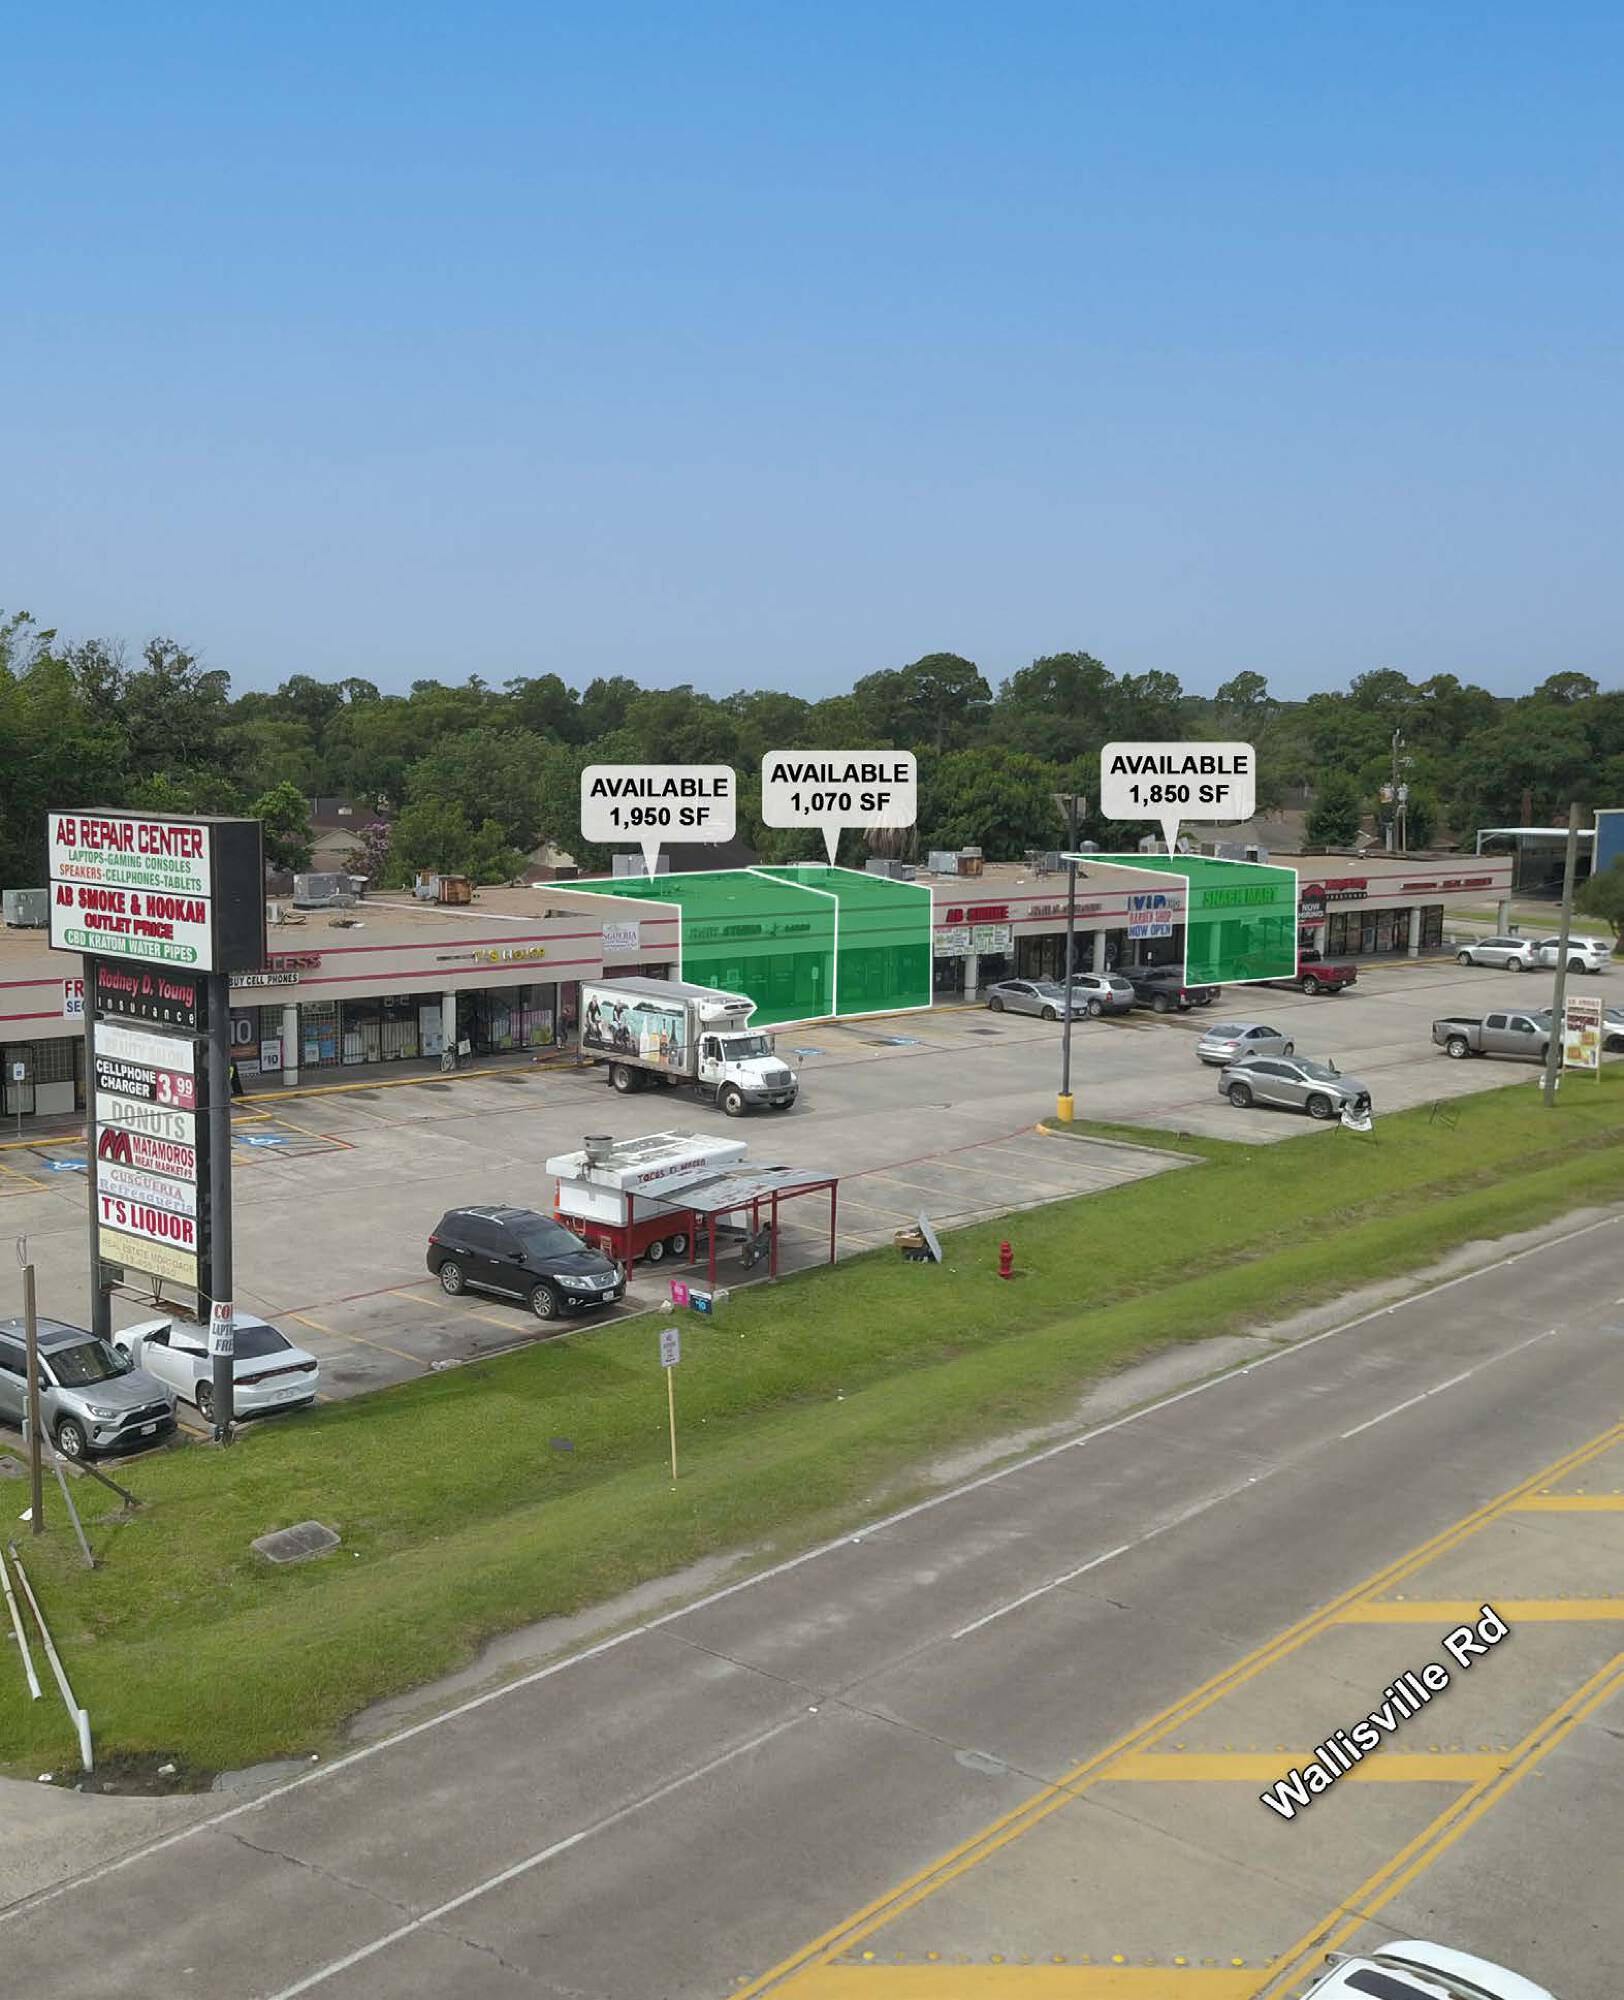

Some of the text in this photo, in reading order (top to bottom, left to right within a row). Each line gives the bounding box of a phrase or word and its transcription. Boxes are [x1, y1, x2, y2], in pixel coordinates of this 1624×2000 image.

[56, 818, 204, 859] AB REPAIR CENTER
[145, 856, 191, 874] CONSOLES
[56, 885, 206, 924] AB SMOKE & HOOKAH
[1302, 903, 1319, 912] NOW
[84, 913, 174, 940] OUTLET PRICE
[1129, 923, 1171, 937] NOW OPEN
[67, 930, 193, 960] CBD KRATOM WATER PIPES
[98, 967, 194, 1007] Rodney D. Young
[246, 975, 265, 985] CELL
[268, 973, 298, 984] PHONES
[98, 996, 194, 1024] Insurance
[96, 1059, 157, 1085] CELLPHONE
[101, 1075, 150, 1098] CHARGER
[112, 1101, 185, 1140] DONUTS
[133, 1136, 194, 1168] MATAMOROS
[135, 1155, 154, 1168] MEAT
[155, 1159, 183, 1175] MARKET
[102, 1196, 193, 1244] T'S LIQUOR
